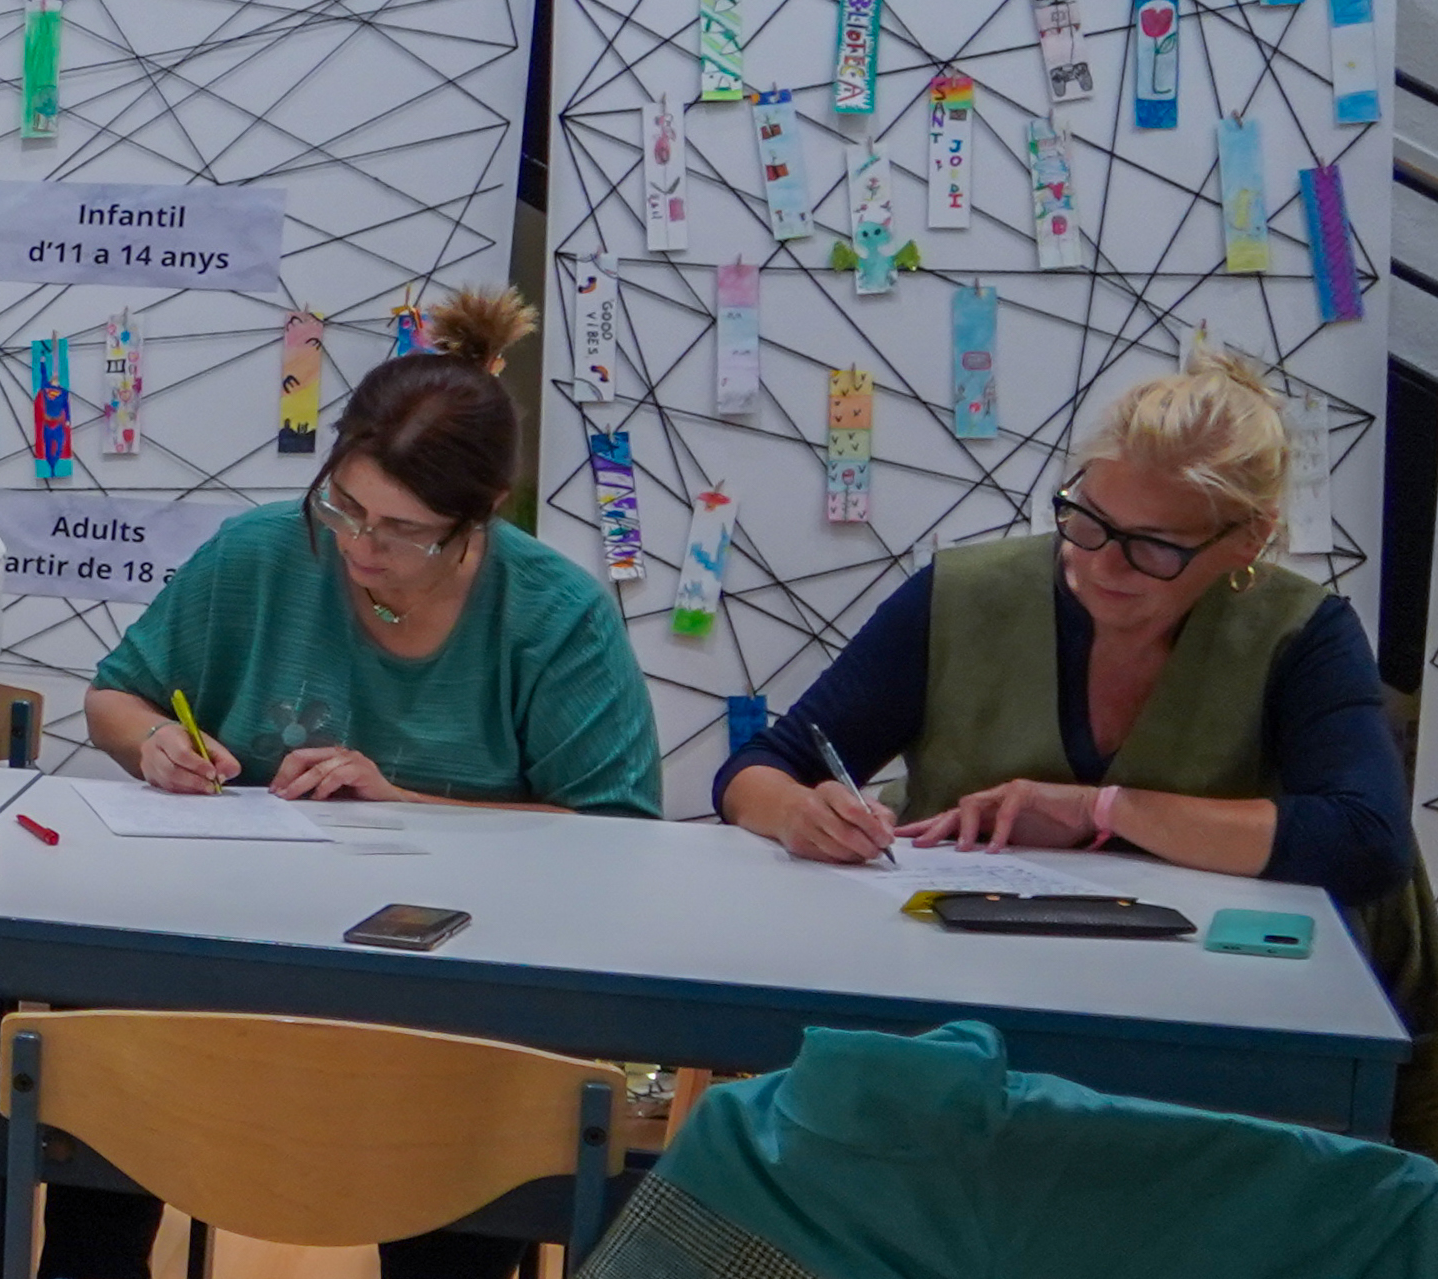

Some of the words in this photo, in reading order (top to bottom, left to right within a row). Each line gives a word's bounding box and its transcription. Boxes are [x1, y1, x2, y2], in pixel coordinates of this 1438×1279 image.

[80, 204, 185, 227] Infantil
[94, 249, 109, 264] a
[122, 245, 151, 265] 14
[161, 251, 228, 274] anys
[51, 517, 145, 542] Adults
[78, 557, 111, 579] de
[124, 561, 153, 582] 18
